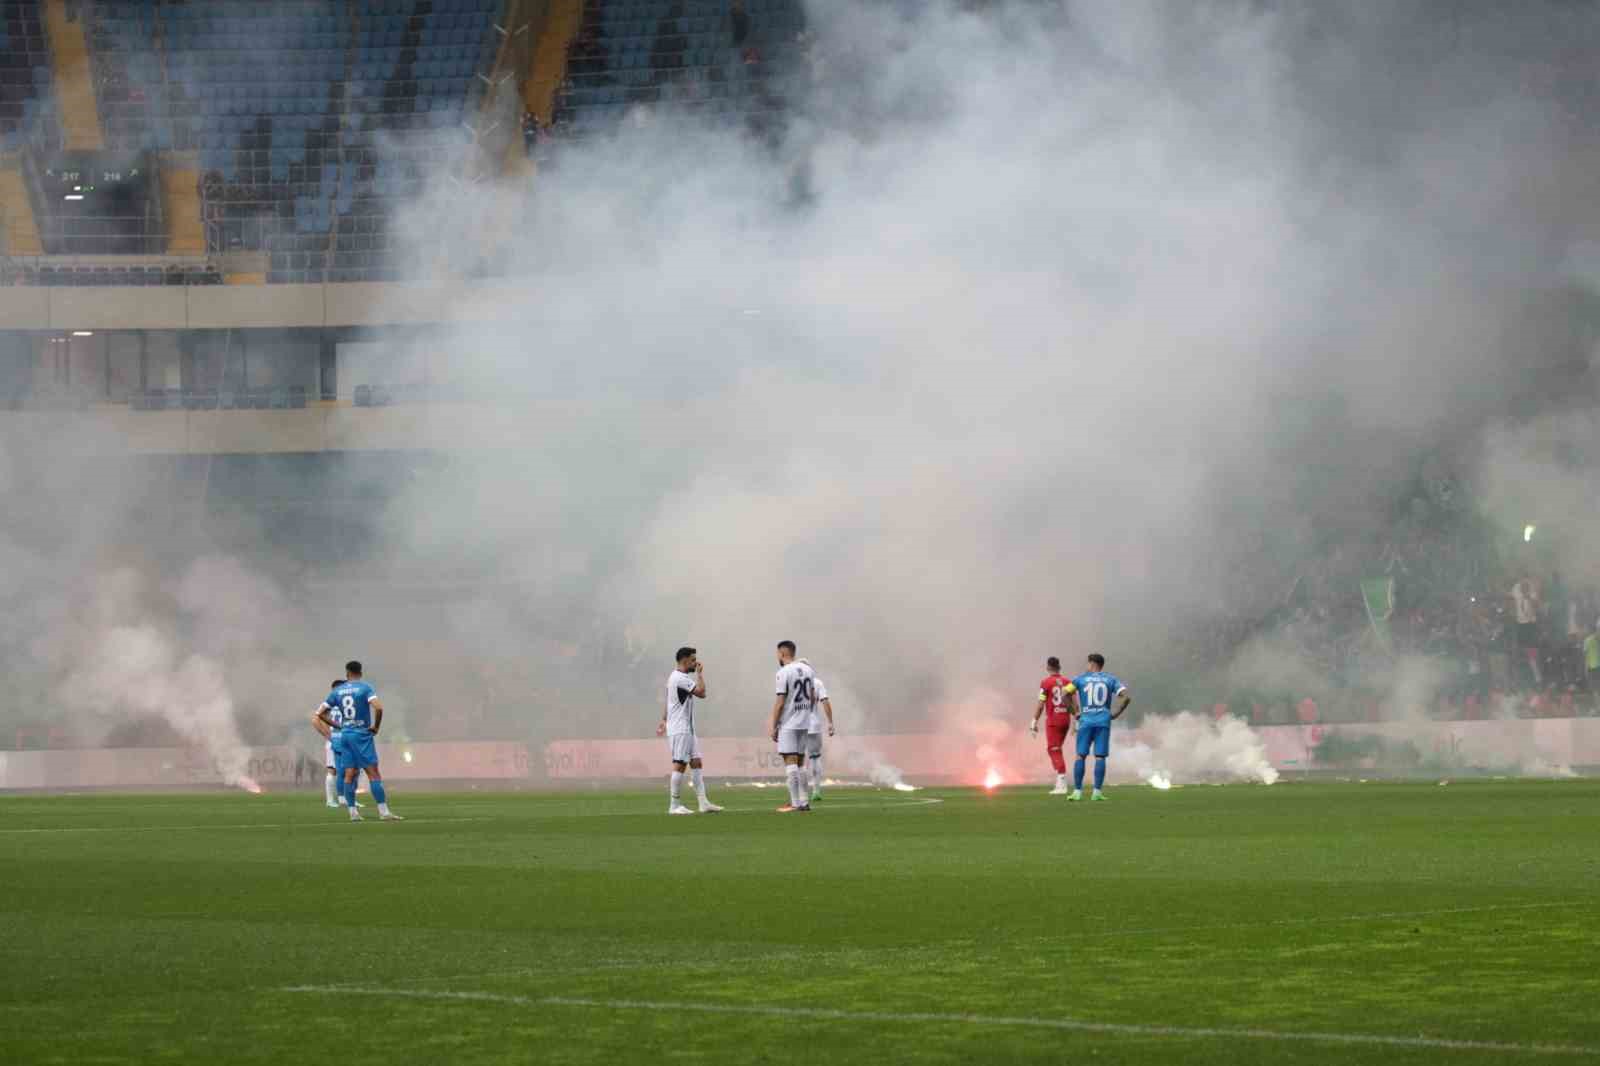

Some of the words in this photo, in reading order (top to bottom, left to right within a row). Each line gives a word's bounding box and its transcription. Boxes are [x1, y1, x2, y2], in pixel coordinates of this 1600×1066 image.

[794, 677, 811, 702] 20
[1083, 682, 1108, 706] 10
[342, 695, 356, 719] 8
